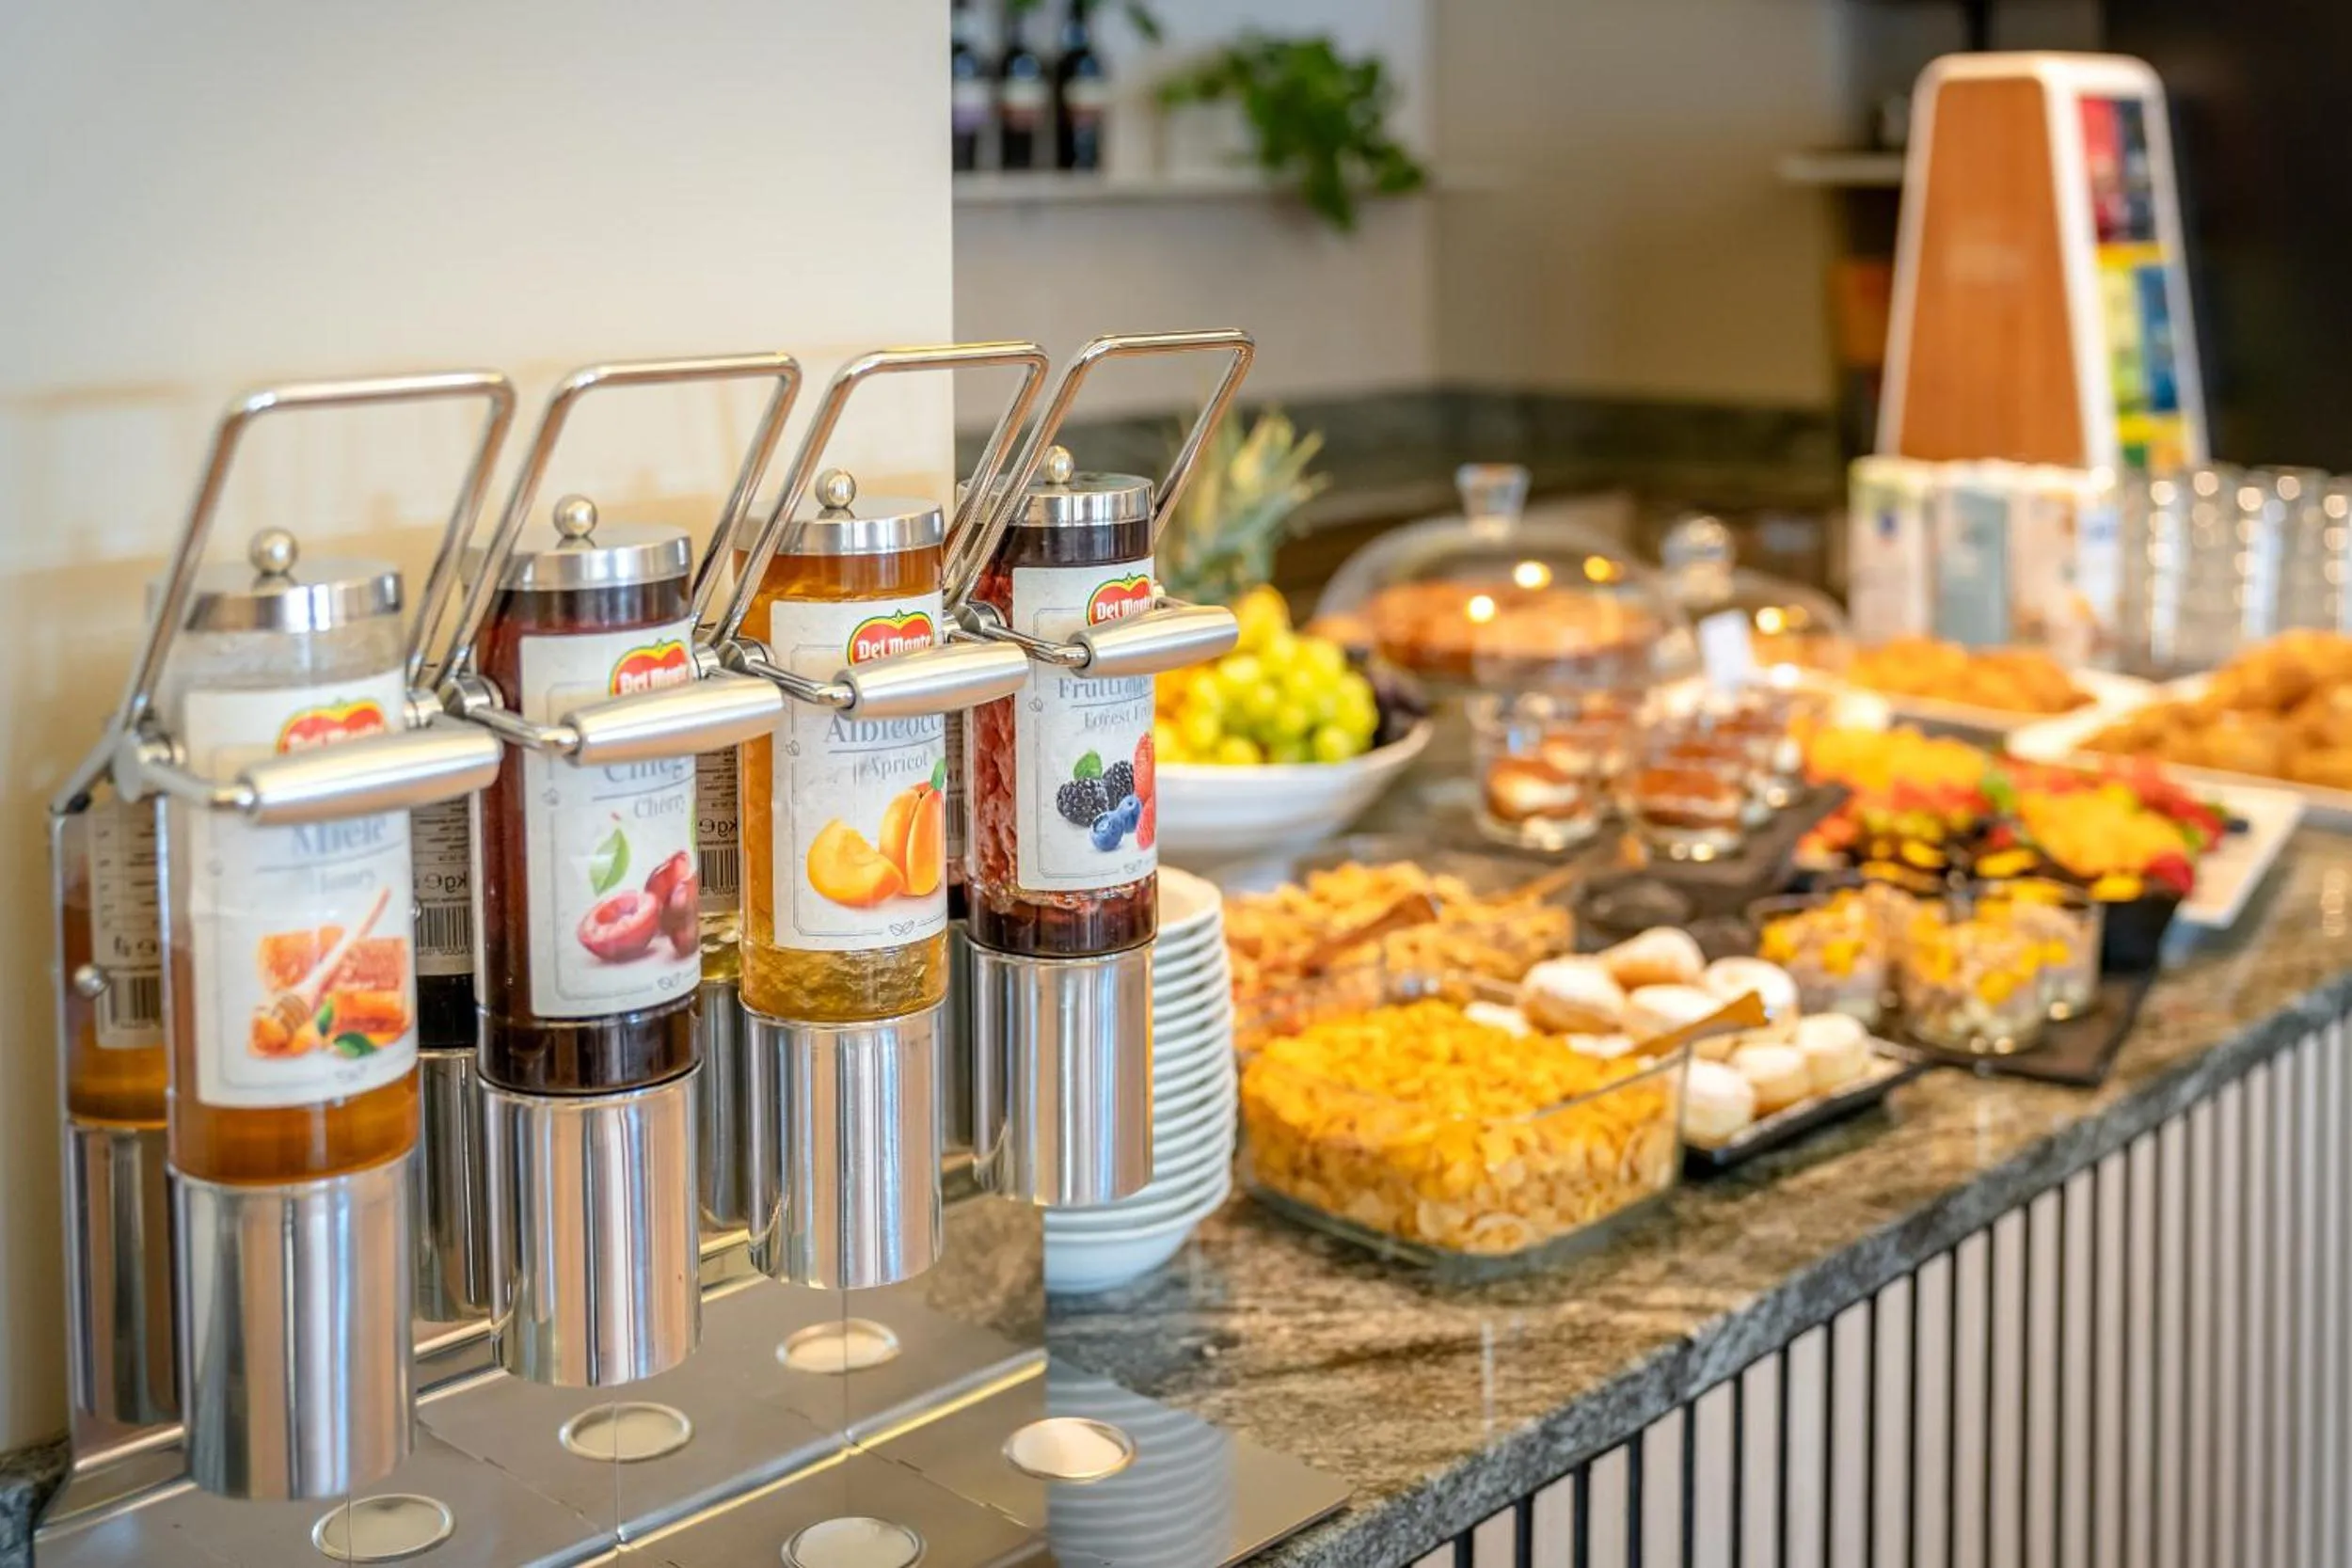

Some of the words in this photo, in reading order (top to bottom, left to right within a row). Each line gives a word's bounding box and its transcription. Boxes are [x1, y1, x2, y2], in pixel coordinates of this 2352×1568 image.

[1096, 599, 1119, 620] Del
[857, 636, 884, 658] Del
[888, 634, 930, 656] Monte
[866, 750, 928, 780] Apricot
